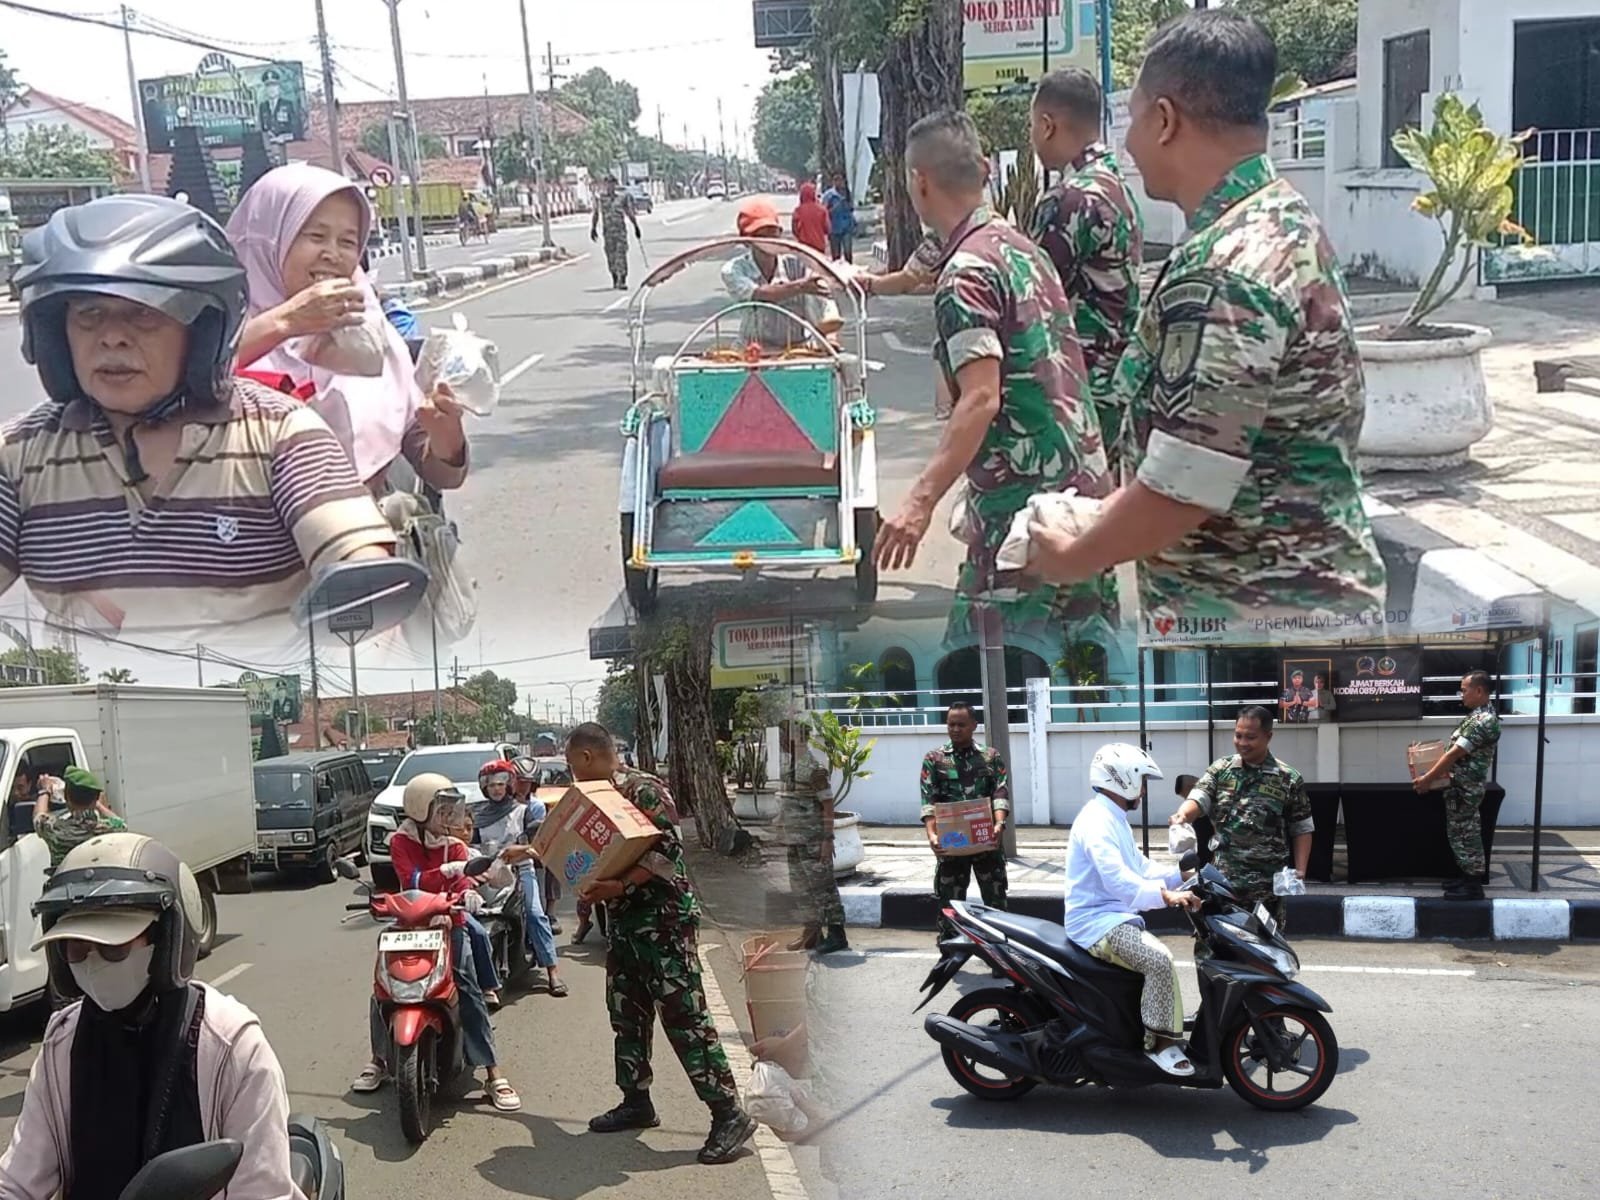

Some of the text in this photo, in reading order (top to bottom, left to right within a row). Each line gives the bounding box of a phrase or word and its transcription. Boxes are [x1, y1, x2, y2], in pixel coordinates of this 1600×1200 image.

[963, 1, 998, 21] OKO
[1016, 20, 1034, 31] ADA
[1177, 616, 1227, 635] BJBR
[728, 627, 758, 644] TOKO
[1334, 687, 1358, 695] KODIM
[1349, 679, 1405, 688] JUMAT BERKAH
[590, 821, 606, 841] 48
[597, 829, 611, 845] CUP
